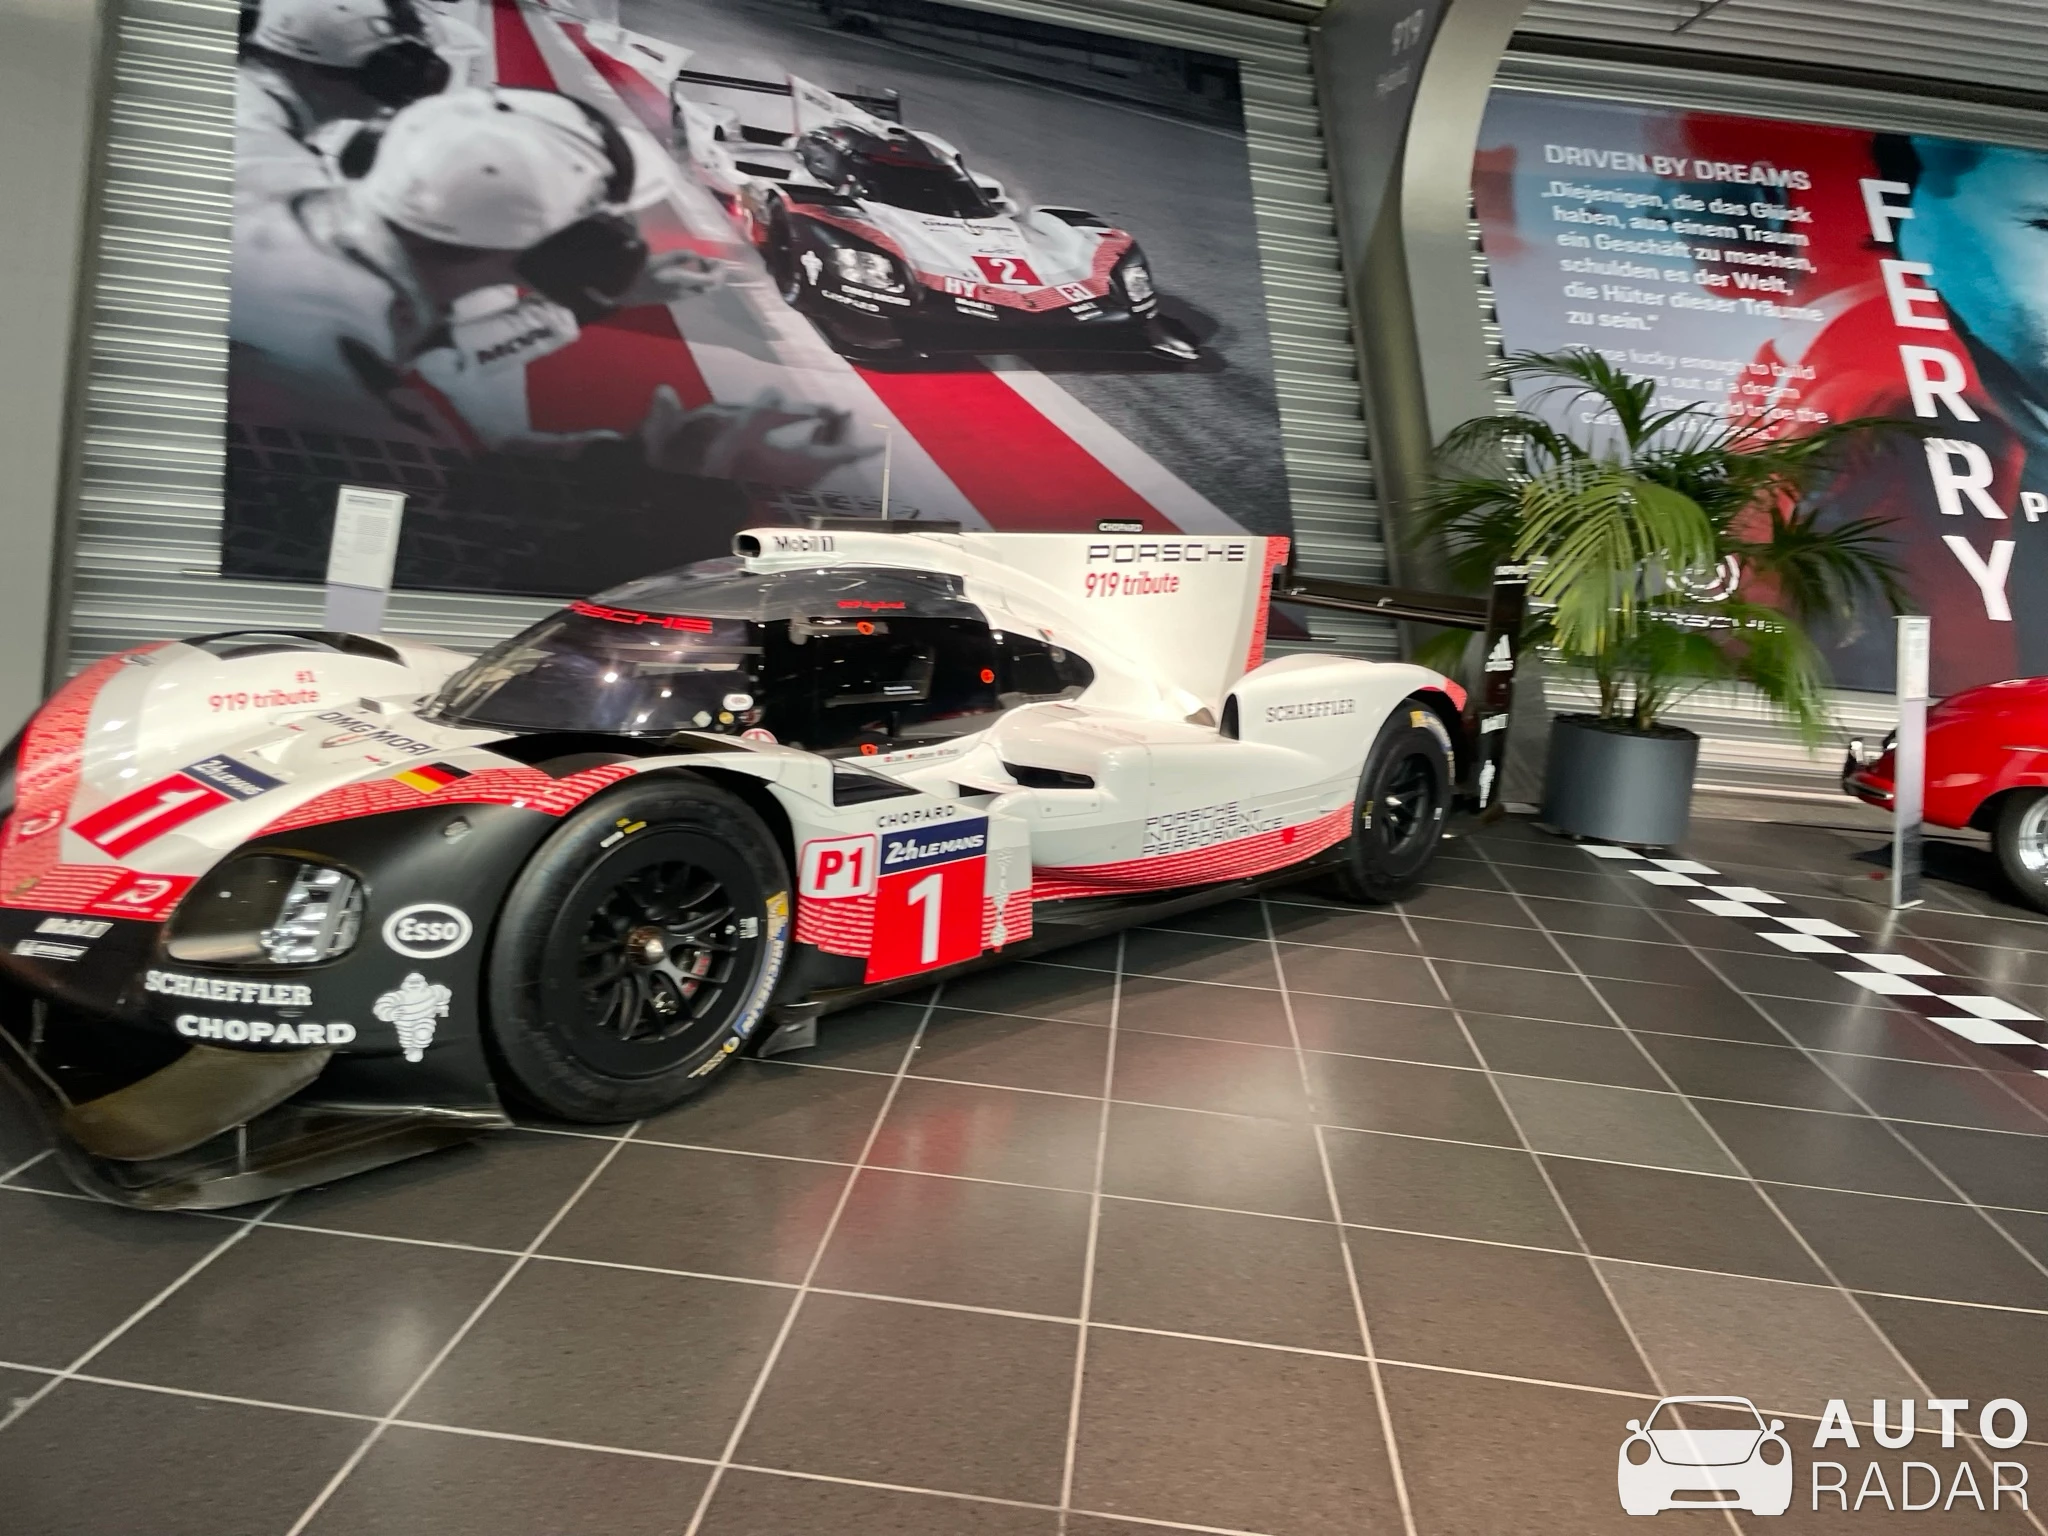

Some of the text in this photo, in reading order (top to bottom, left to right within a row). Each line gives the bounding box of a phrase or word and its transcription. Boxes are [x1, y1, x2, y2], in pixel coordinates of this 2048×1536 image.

[1544, 144, 1812, 191] DRIVEN BY DREAMS
[1672, 194, 1706, 211] die
[1708, 198, 1748, 216] das
[1750, 202, 1814, 223] Glück
[1552, 205, 1810, 246] haben, aus einem Traum
[1557, 231, 1817, 273] ein Geschäft zu machen,
[989, 258, 1028, 285] 2
[1560, 257, 1794, 296] schulden es der Welt,
[945, 276, 977, 298] HY
[1564, 281, 1825, 322] die Hüter dieser Träume
[1565, 311, 1594, 325] zu
[1726, 383, 1739, 393] a
[1087, 544, 1247, 564] PORSCHE
[1085, 571, 1180, 598] 919 tribute
[208, 689, 320, 712] 919 tribute
[1266, 699, 1356, 723] SCHAEFFLER
[316, 711, 441, 756] DMG MORI
[95, 790, 209, 845] 1
[877, 805, 956, 828] CHOPARD
[1146, 801, 1238, 827] PORSCHE
[815, 846, 865, 890] P1
[397, 918, 460, 941] Esso
[907, 873, 943, 964] 1
[145, 970, 313, 1006] SCHAEFFLER
[176, 1015, 357, 1044] CHOPARD
